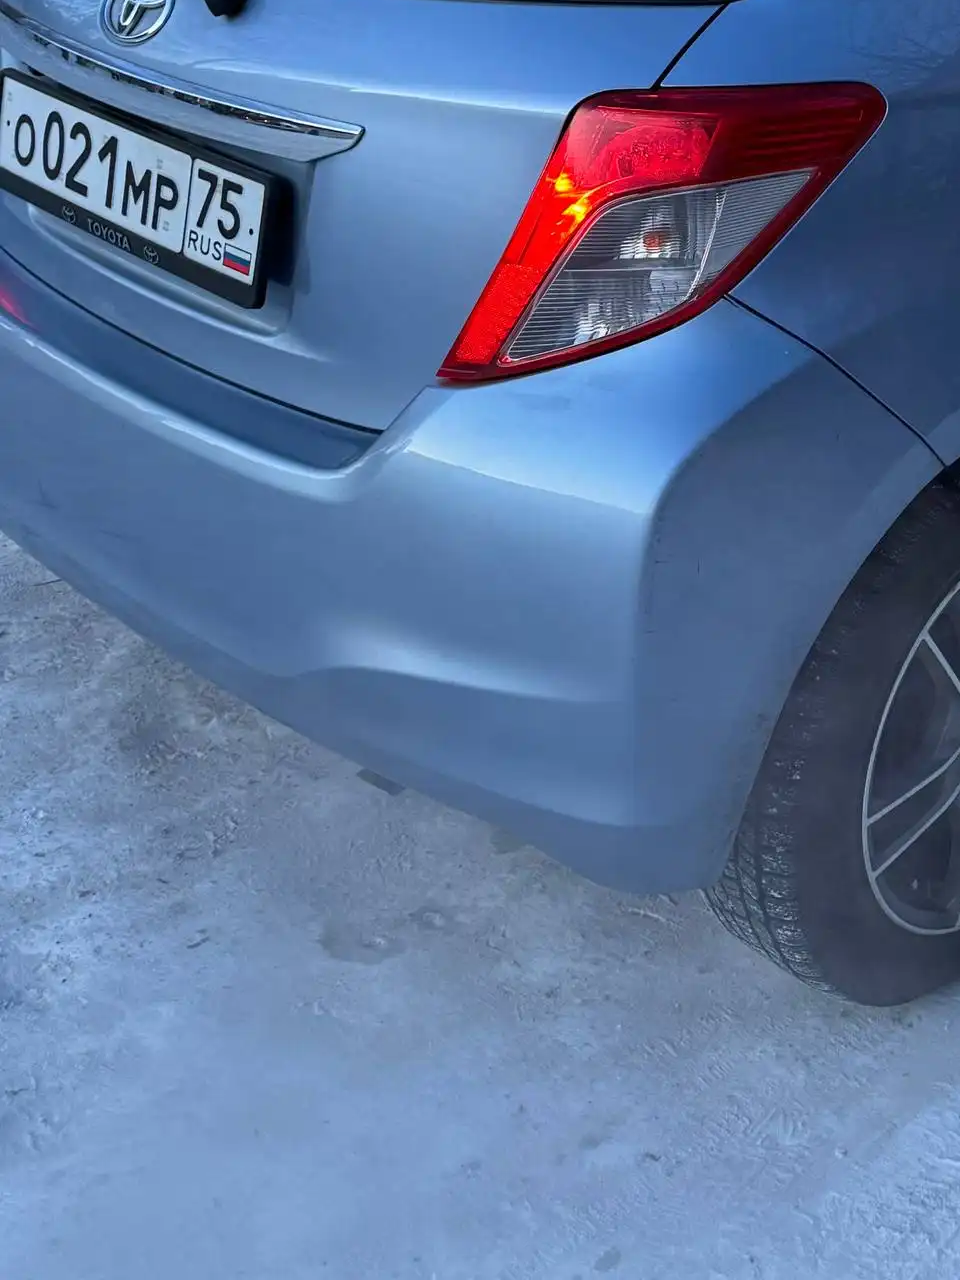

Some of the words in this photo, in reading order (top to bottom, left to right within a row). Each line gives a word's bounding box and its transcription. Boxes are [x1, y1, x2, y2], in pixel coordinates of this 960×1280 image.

[196, 167, 244, 240] 75
[87, 218, 131, 252] TOYOTA
[188, 230, 222, 261] RUS
